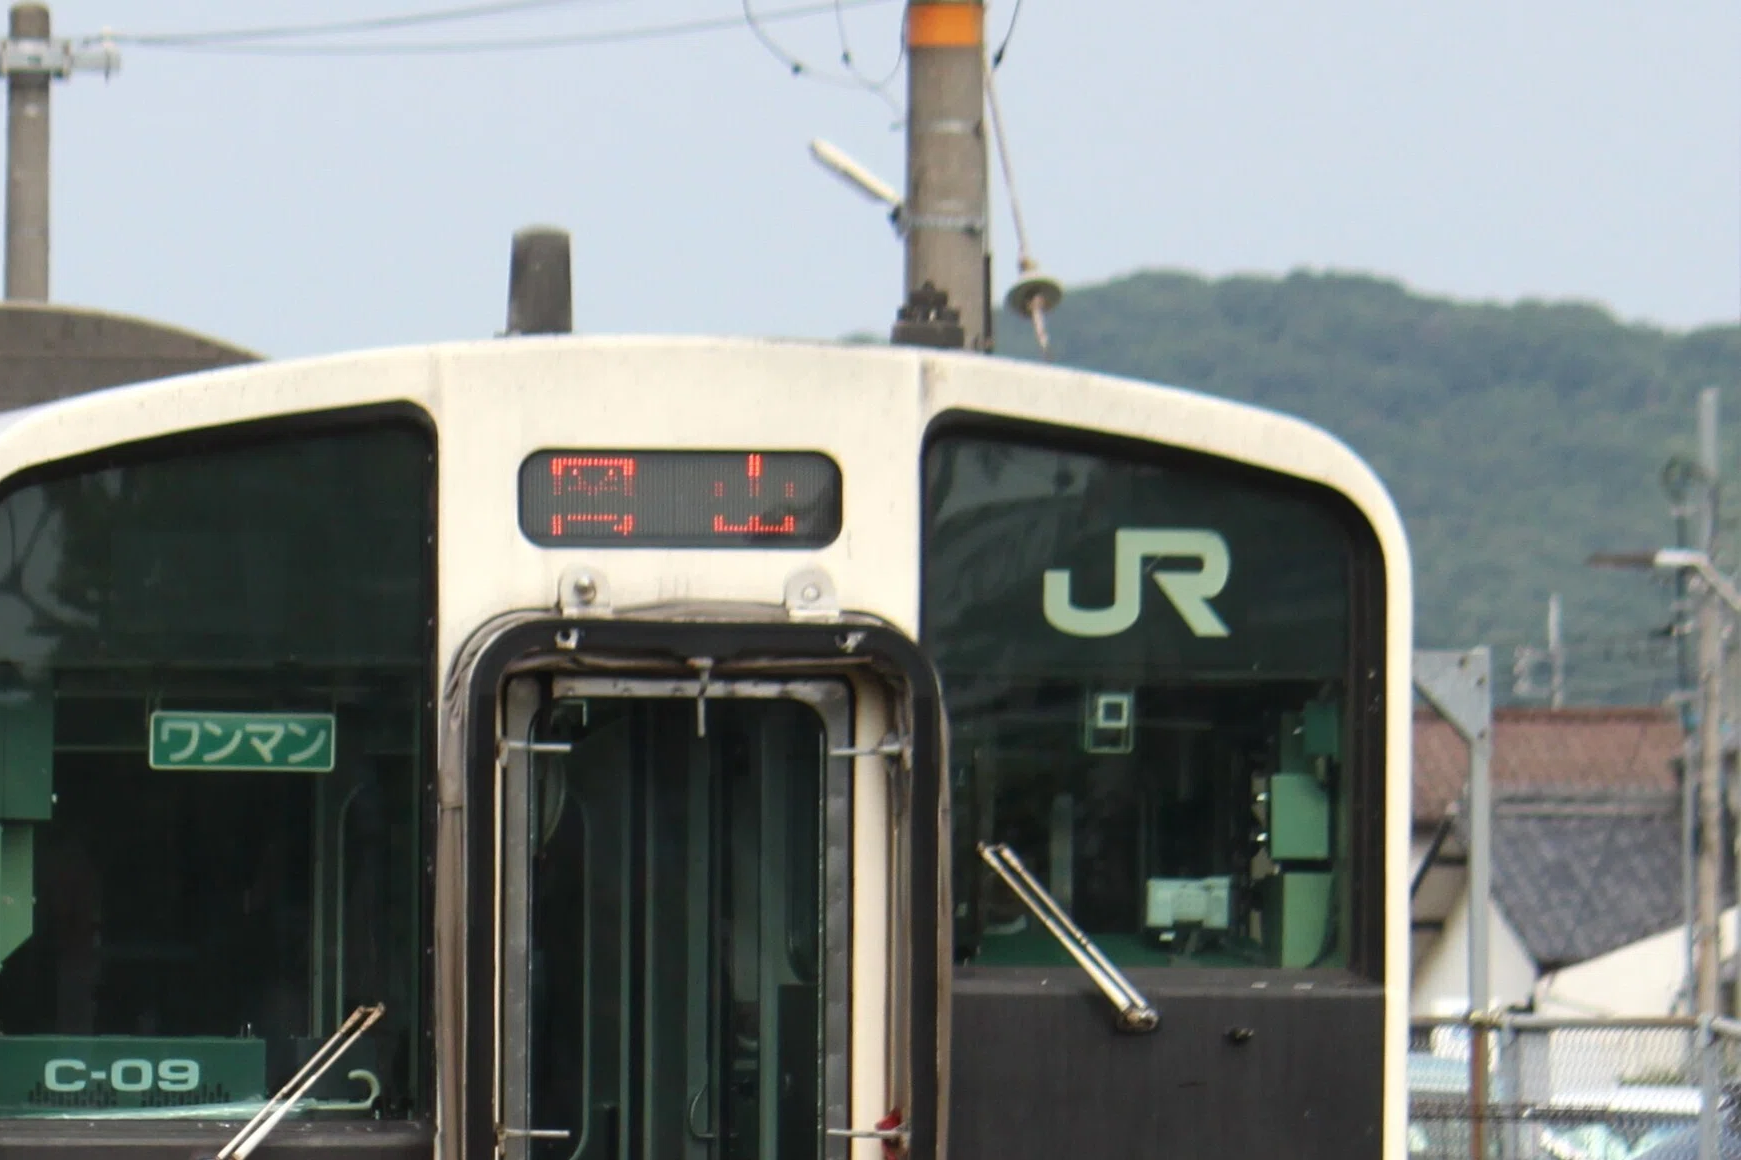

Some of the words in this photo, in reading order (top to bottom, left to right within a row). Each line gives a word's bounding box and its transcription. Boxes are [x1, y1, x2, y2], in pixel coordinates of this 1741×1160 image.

[1042, 527, 1232, 637] JR
[161, 721, 326, 764] ワンマン
[43, 1058, 201, 1092] C-09
